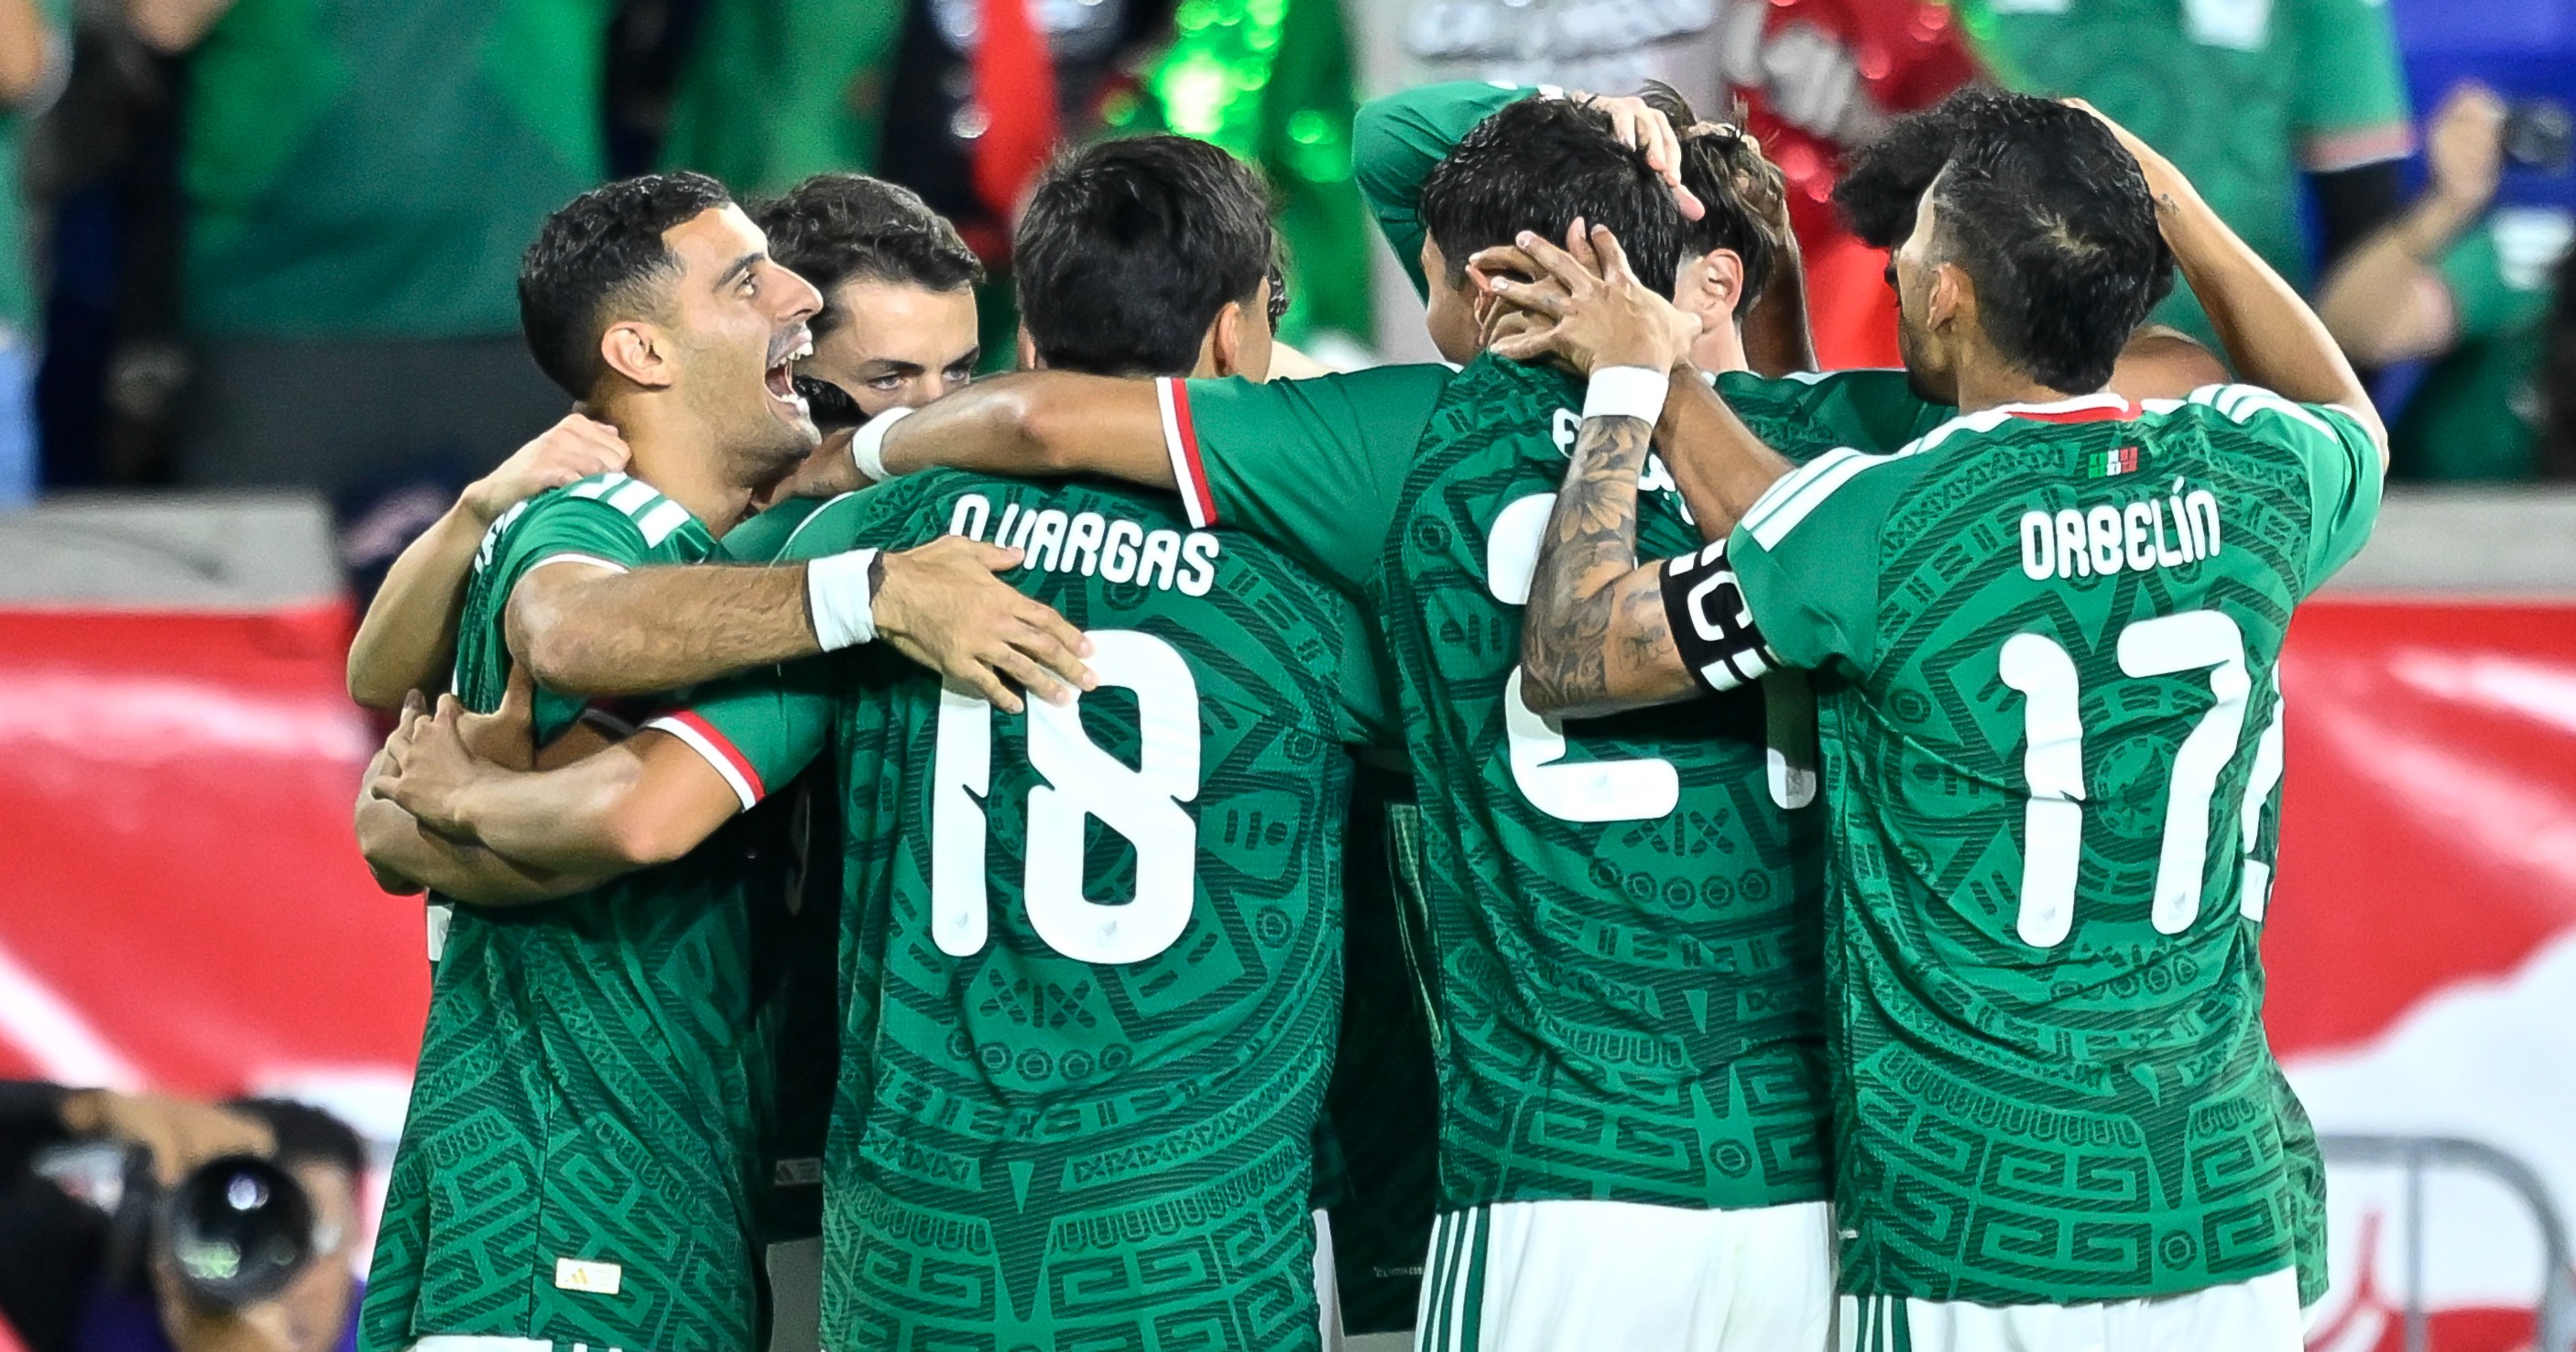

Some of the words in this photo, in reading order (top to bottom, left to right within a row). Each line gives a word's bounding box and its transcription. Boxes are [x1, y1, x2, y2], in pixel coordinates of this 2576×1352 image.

[1687, 571, 1753, 641] C
[2020, 475, 2221, 581] ORBELÍN
[931, 629, 1201, 964] 18
[1999, 609, 2252, 948] 17
